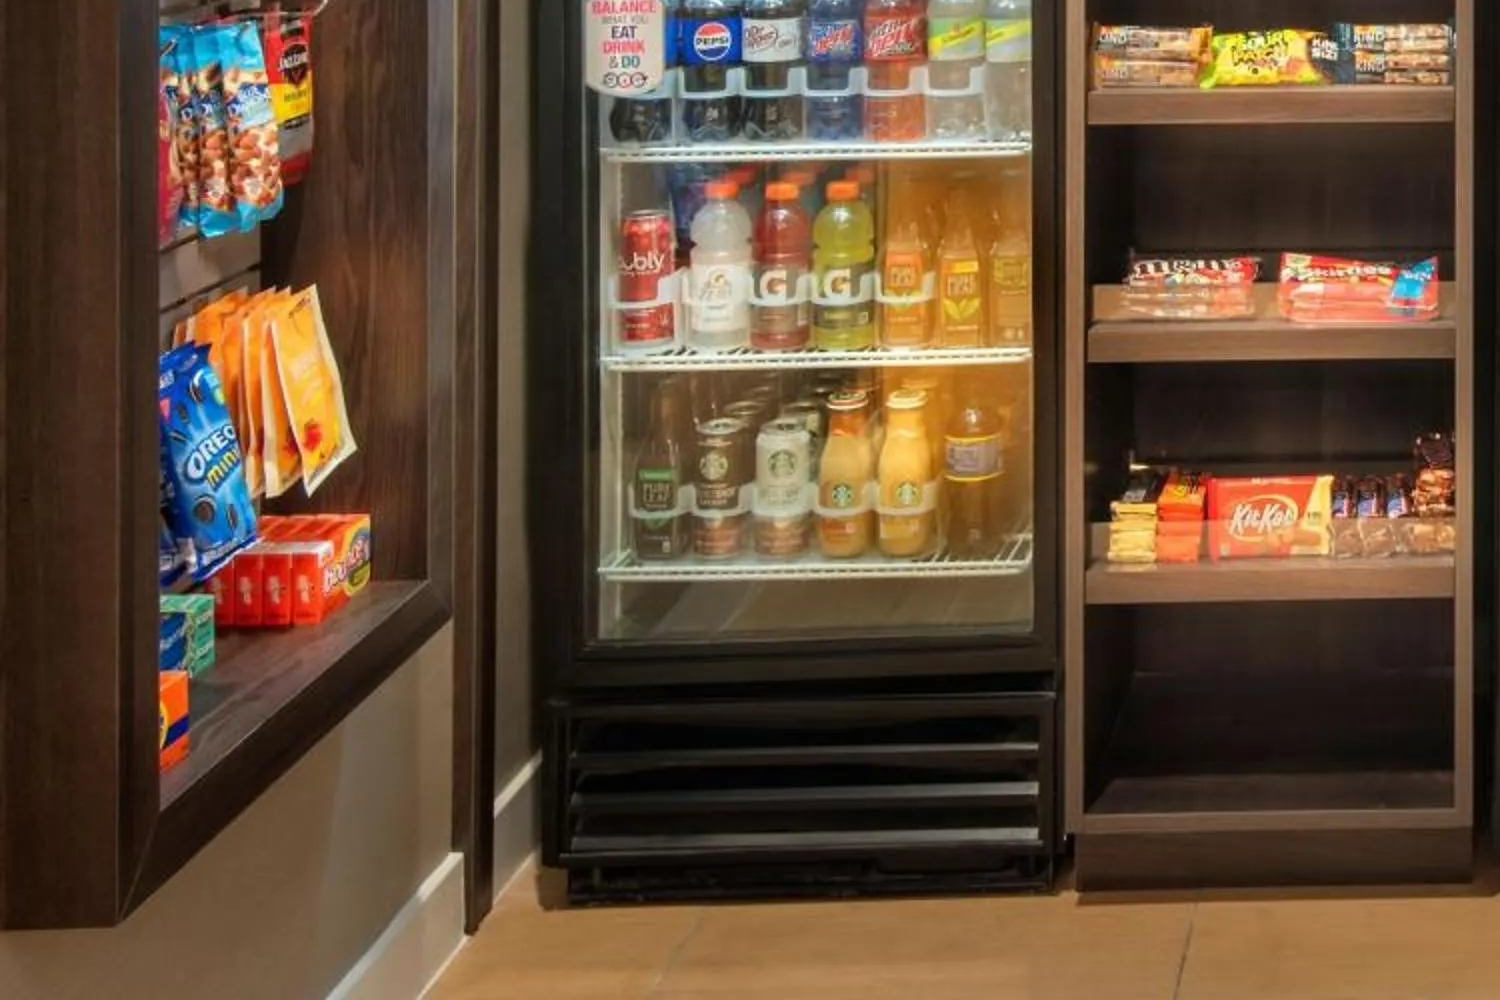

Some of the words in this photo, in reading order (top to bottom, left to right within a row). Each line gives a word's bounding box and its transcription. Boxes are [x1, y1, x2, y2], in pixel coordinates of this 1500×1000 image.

[592, 0, 657, 14] BALANCE
[611, 25, 638, 39] EAT
[694, 37, 731, 46] PEPSI
[621, 55, 641, 69] DO
[620, 252, 665, 273] ubly
[186, 424, 236, 480] OREO
